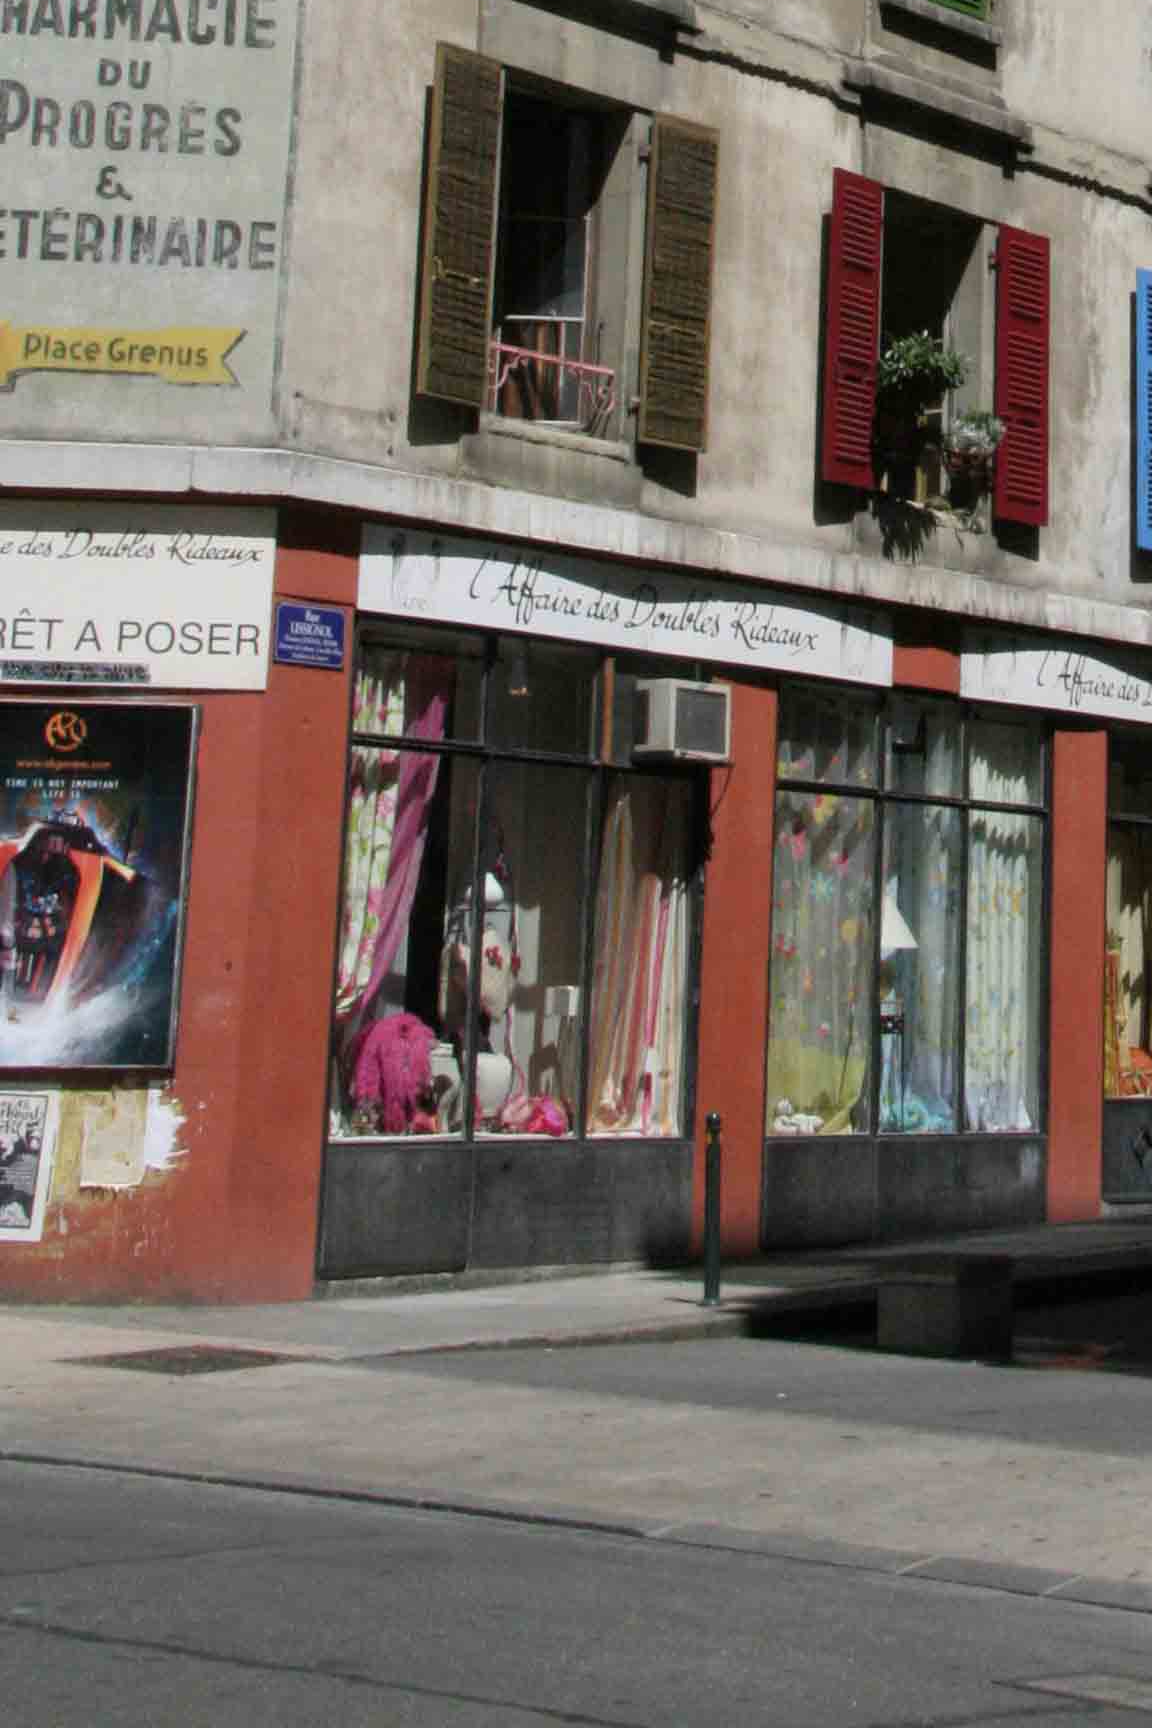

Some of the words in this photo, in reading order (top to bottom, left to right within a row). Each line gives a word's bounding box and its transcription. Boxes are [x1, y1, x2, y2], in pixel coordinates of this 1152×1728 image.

[97, 57, 151, 90] DU
[96, 165, 134, 202] &
[23, 332, 98, 362] Place
[107, 336, 209, 368] Grenus
[17, 528, 52, 559] des
[57, 528, 156, 560] Doubles
[167, 529, 265, 567] Rideaux
[74, 619, 102, 652] A
[117, 620, 261, 657] POSER
[587, 585, 620, 622] des
[624, 583, 720, 638] Doubles
[730, 600, 819, 656] Rideaux
[1117, 673, 1141, 703] des
